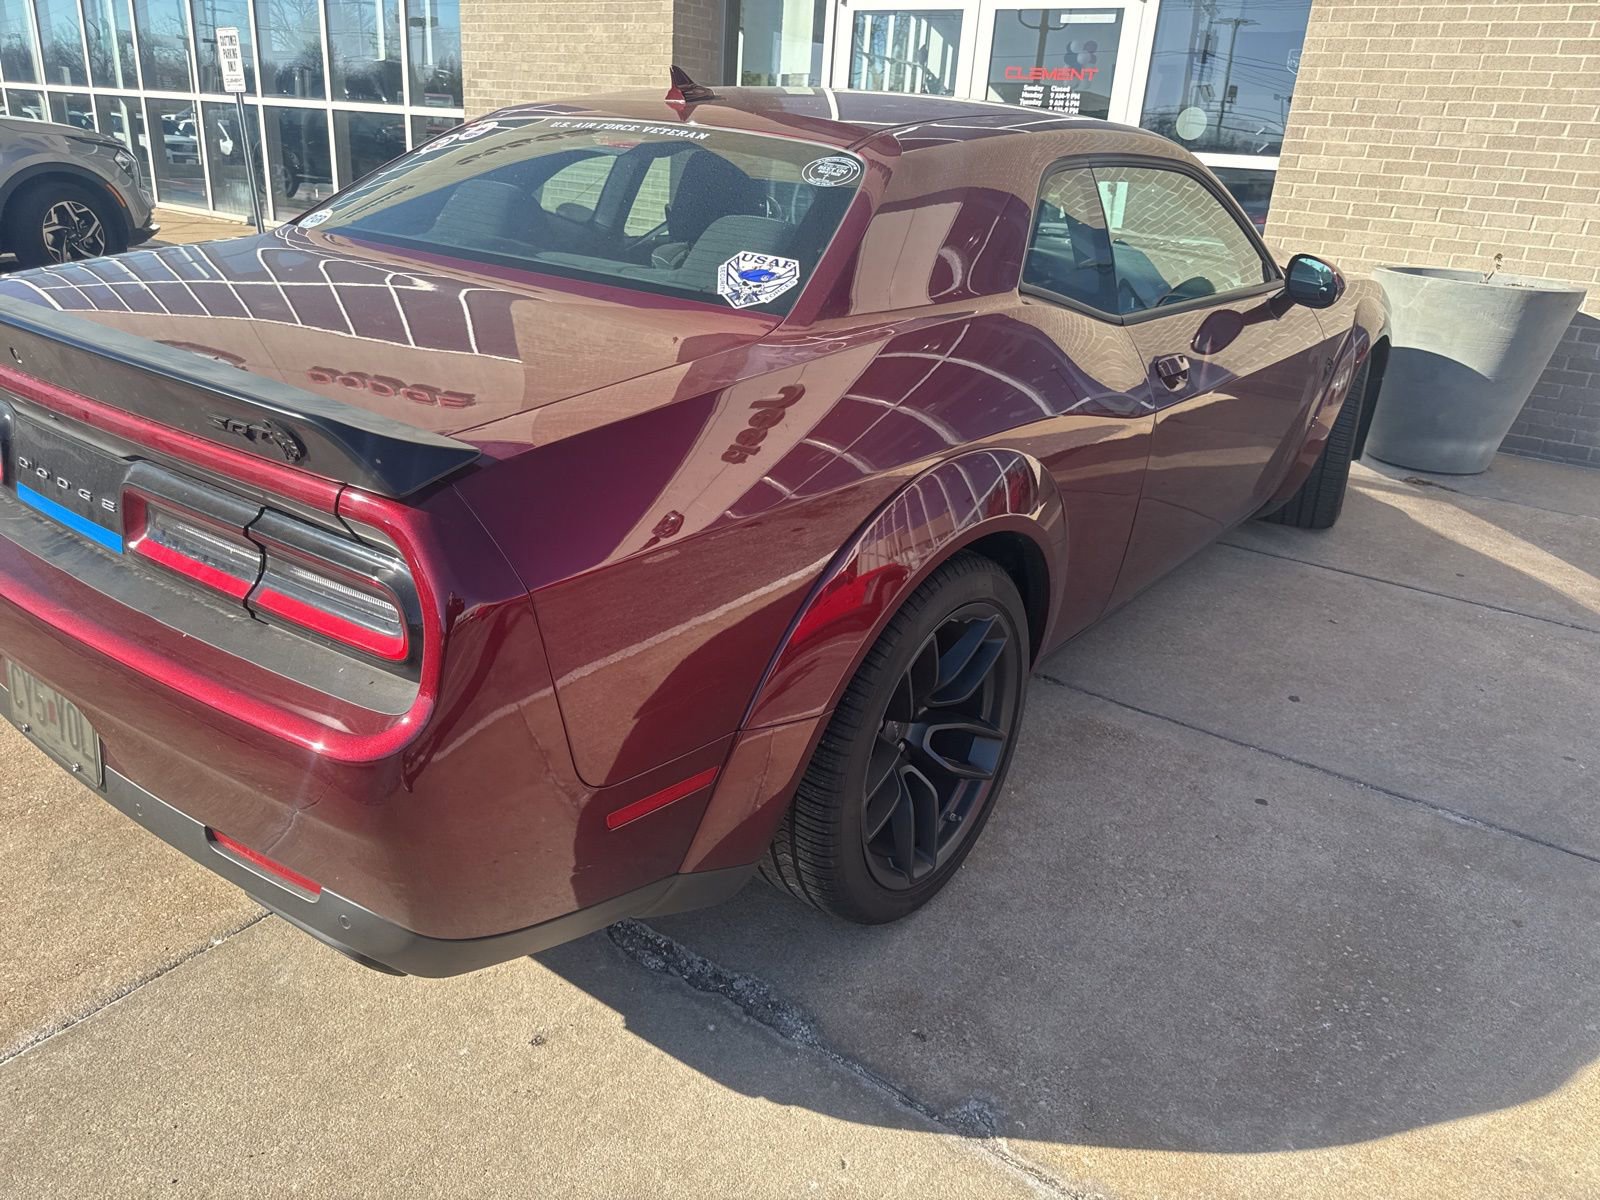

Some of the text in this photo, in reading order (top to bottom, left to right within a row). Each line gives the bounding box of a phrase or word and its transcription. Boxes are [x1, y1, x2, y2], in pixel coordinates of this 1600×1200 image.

[222, 48, 238, 59] PARKING
[1005, 66, 1099, 81] CLEMENT
[1021, 91, 1044, 99] Monday
[1023, 84, 1044, 92] Sunday
[1019, 98, 1043, 107] Tuesday
[597, 122, 640, 132] FORCE
[642, 126, 710, 140] VETERAN
[741, 253, 796, 269] USAF
[764, 280, 796, 301] FORCES
[18, 456, 118, 513] DODGE
